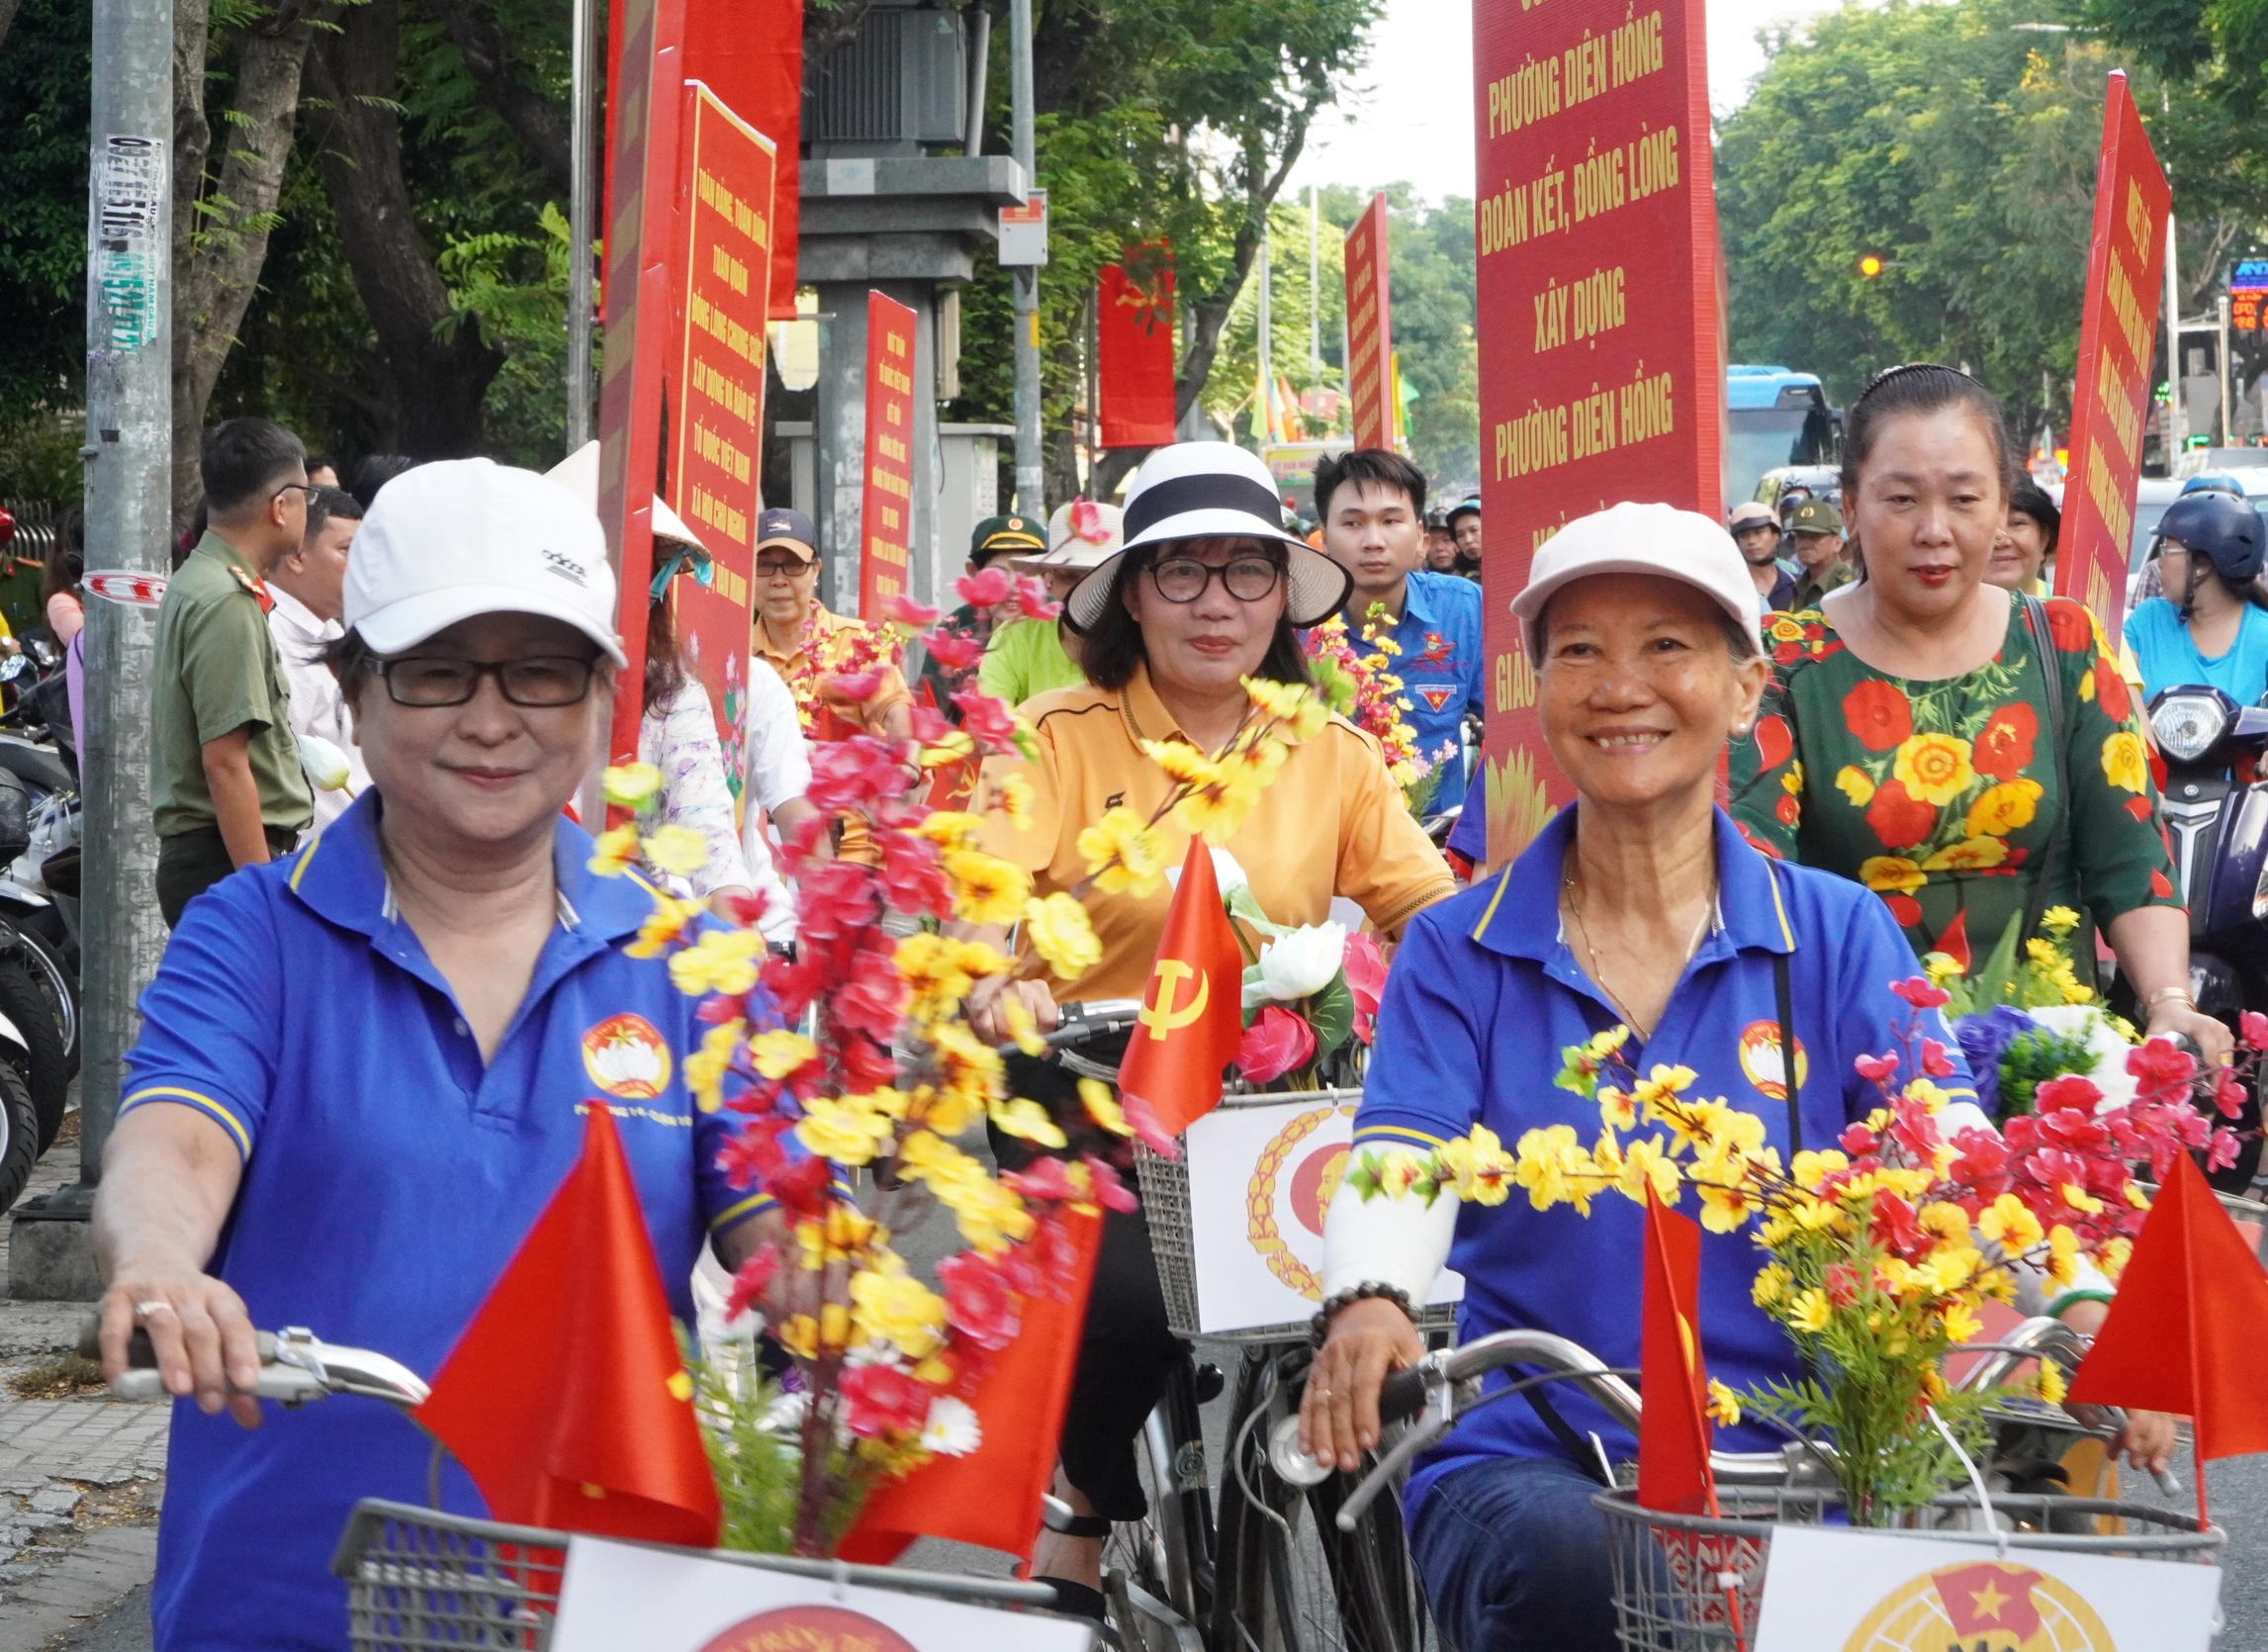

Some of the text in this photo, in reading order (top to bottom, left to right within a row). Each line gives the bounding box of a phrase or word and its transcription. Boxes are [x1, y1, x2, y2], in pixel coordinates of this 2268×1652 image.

[1489, 1, 1664, 139] PHƯỜNG DIÊN HỒNG
[1481, 122, 1678, 257] ĐOÀN KẾT, ĐỒNG LÒNG
[1534, 266, 1625, 353] XÂY DỰNG
[1495, 359, 1674, 482] PHƯỜNG DIÊN HỒNG
[1496, 638, 1536, 713] GIÀU
